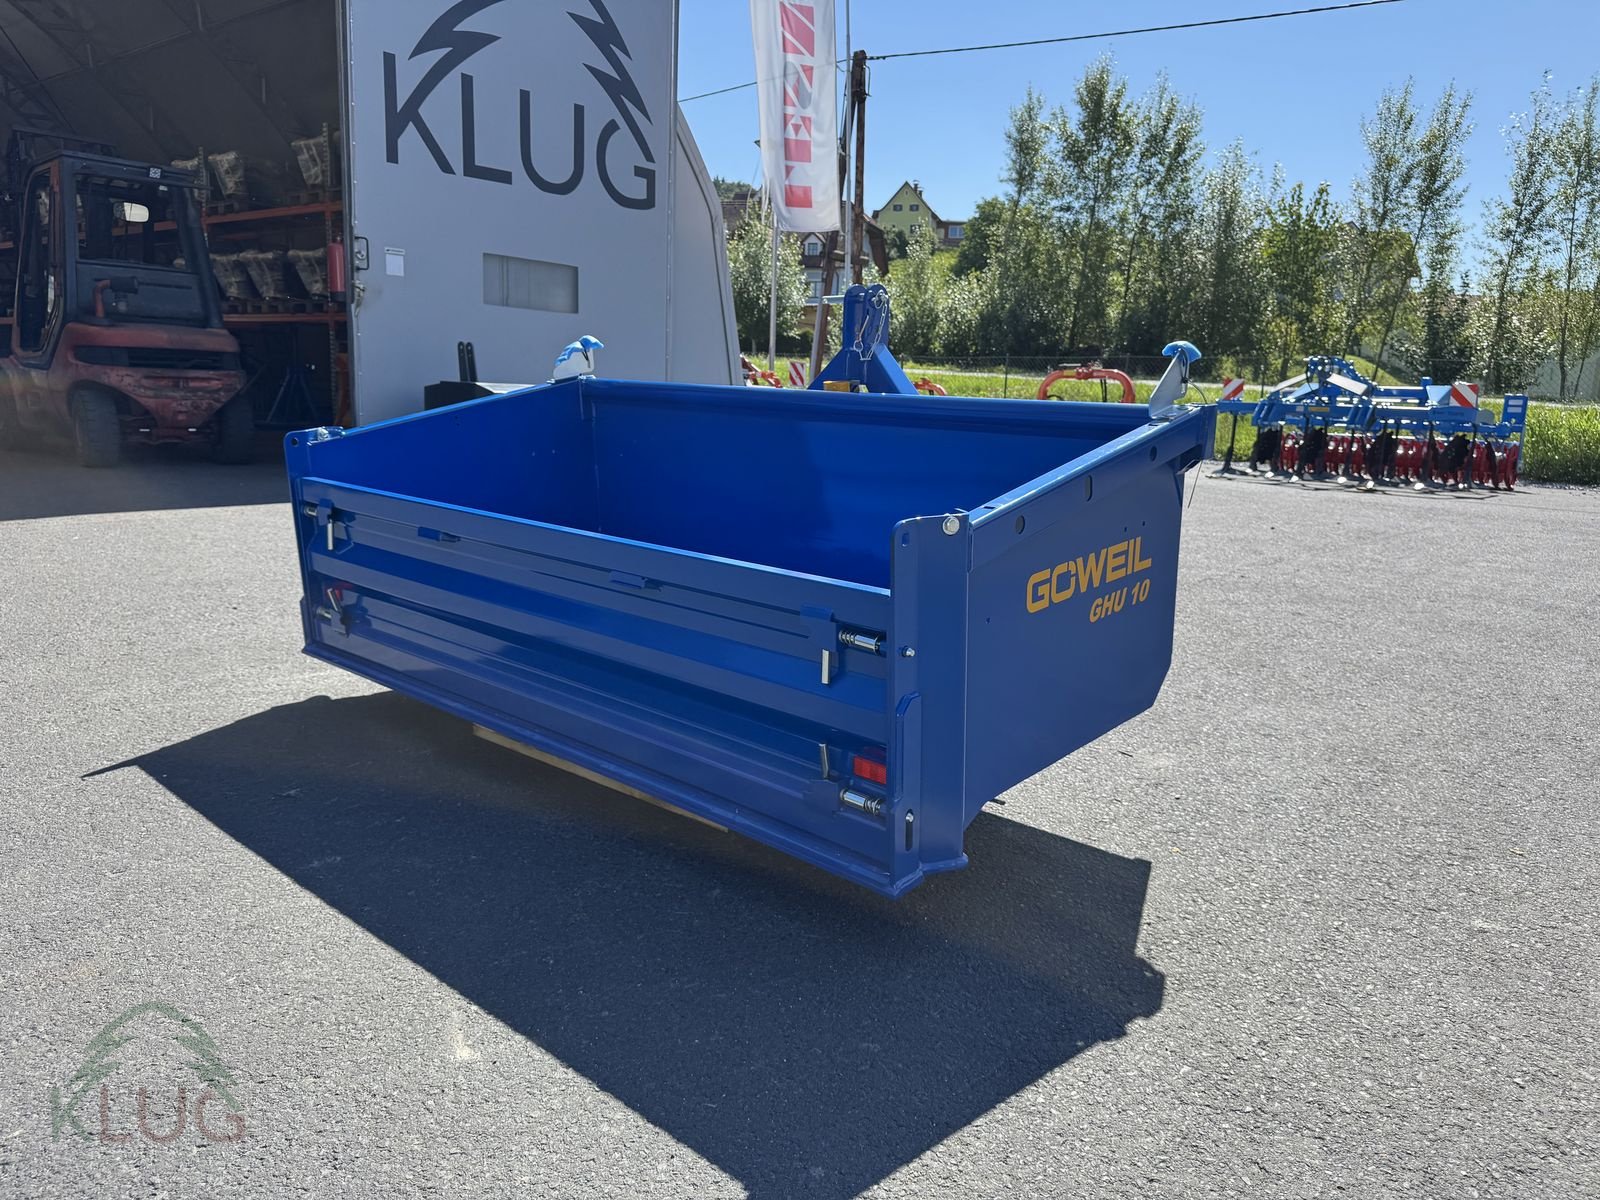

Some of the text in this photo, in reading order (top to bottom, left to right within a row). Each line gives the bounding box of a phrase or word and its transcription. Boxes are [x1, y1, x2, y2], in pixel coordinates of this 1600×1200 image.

[383, 51, 656, 210] KLUG
[1089, 578, 1151, 623] GHU 10
